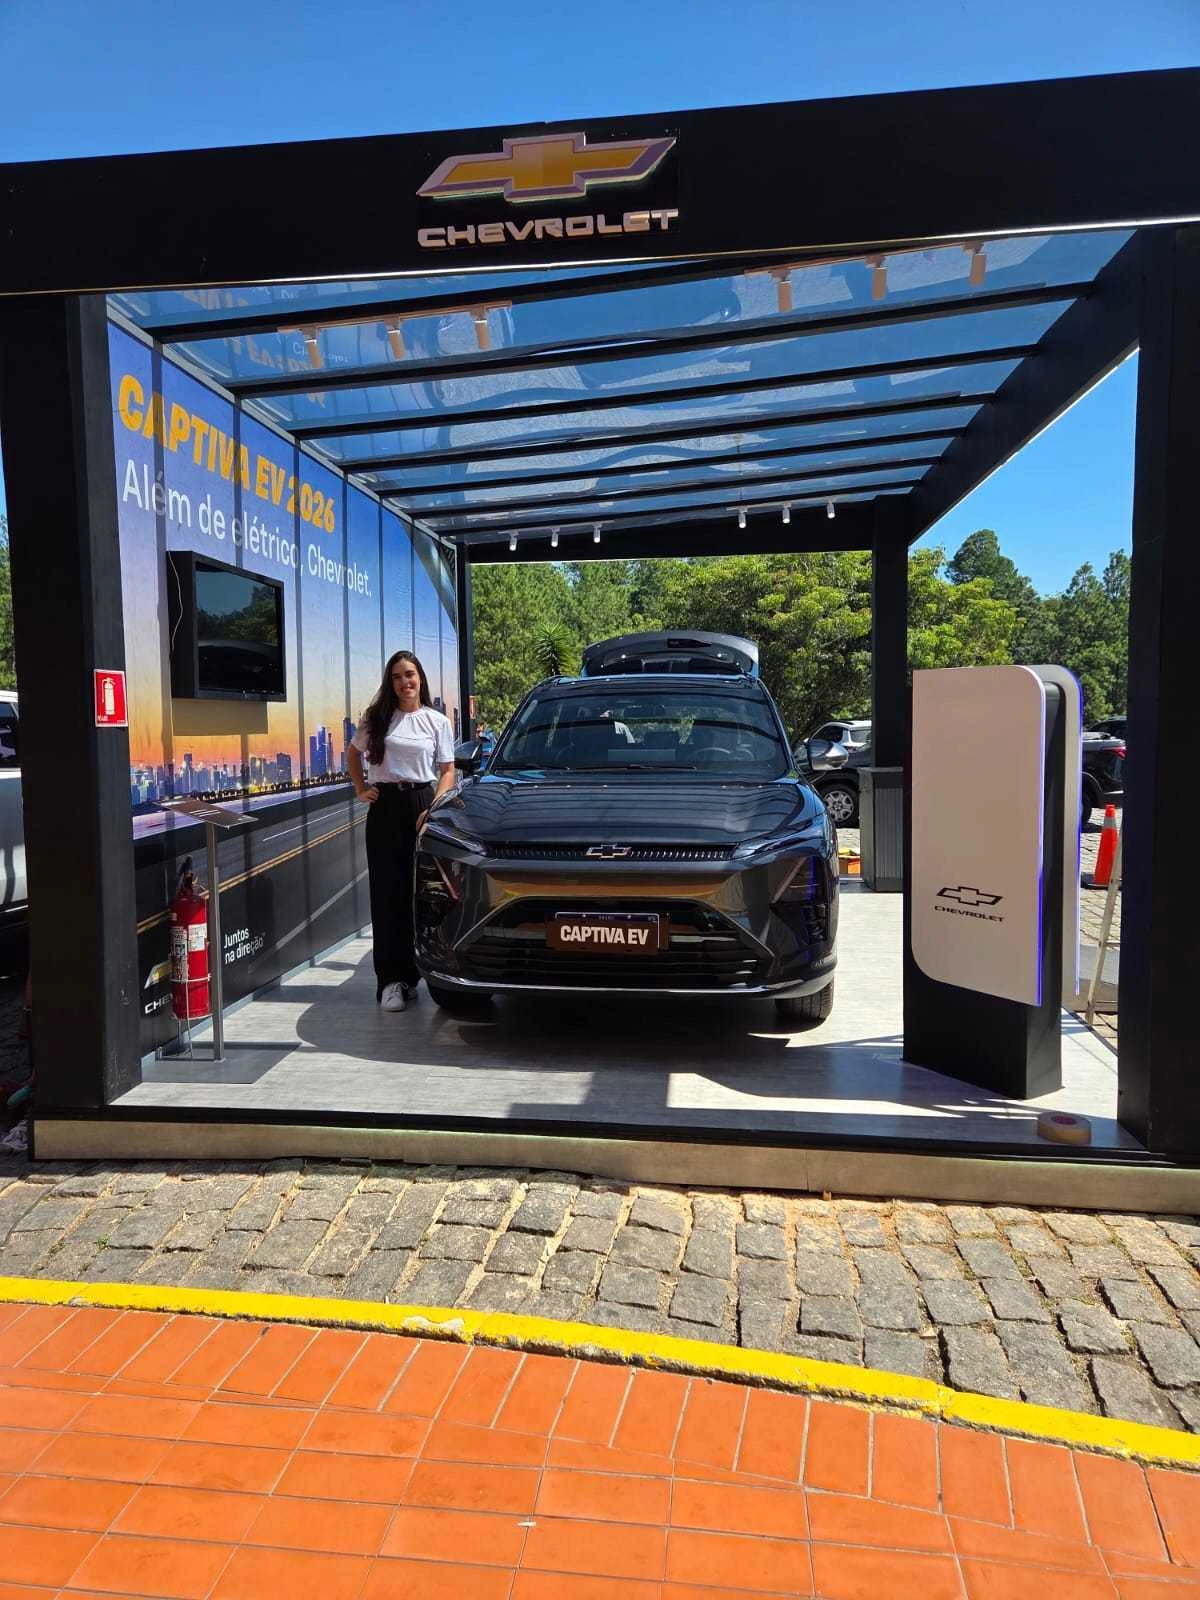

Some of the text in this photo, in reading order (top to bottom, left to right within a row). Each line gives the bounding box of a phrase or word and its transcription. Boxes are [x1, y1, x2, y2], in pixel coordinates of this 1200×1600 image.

[417, 208, 679, 248] CHEVROLET
[118, 373, 335, 534] CAPTIVA EV 2026
[122, 459, 374, 598] Além de elétrico, Chevrolet.
[934, 905, 1004, 922] CHEVROLET
[223, 927, 250, 949] Juntos
[560, 925, 649, 945] CAPTIVA EV
[224, 950, 236, 965] na
